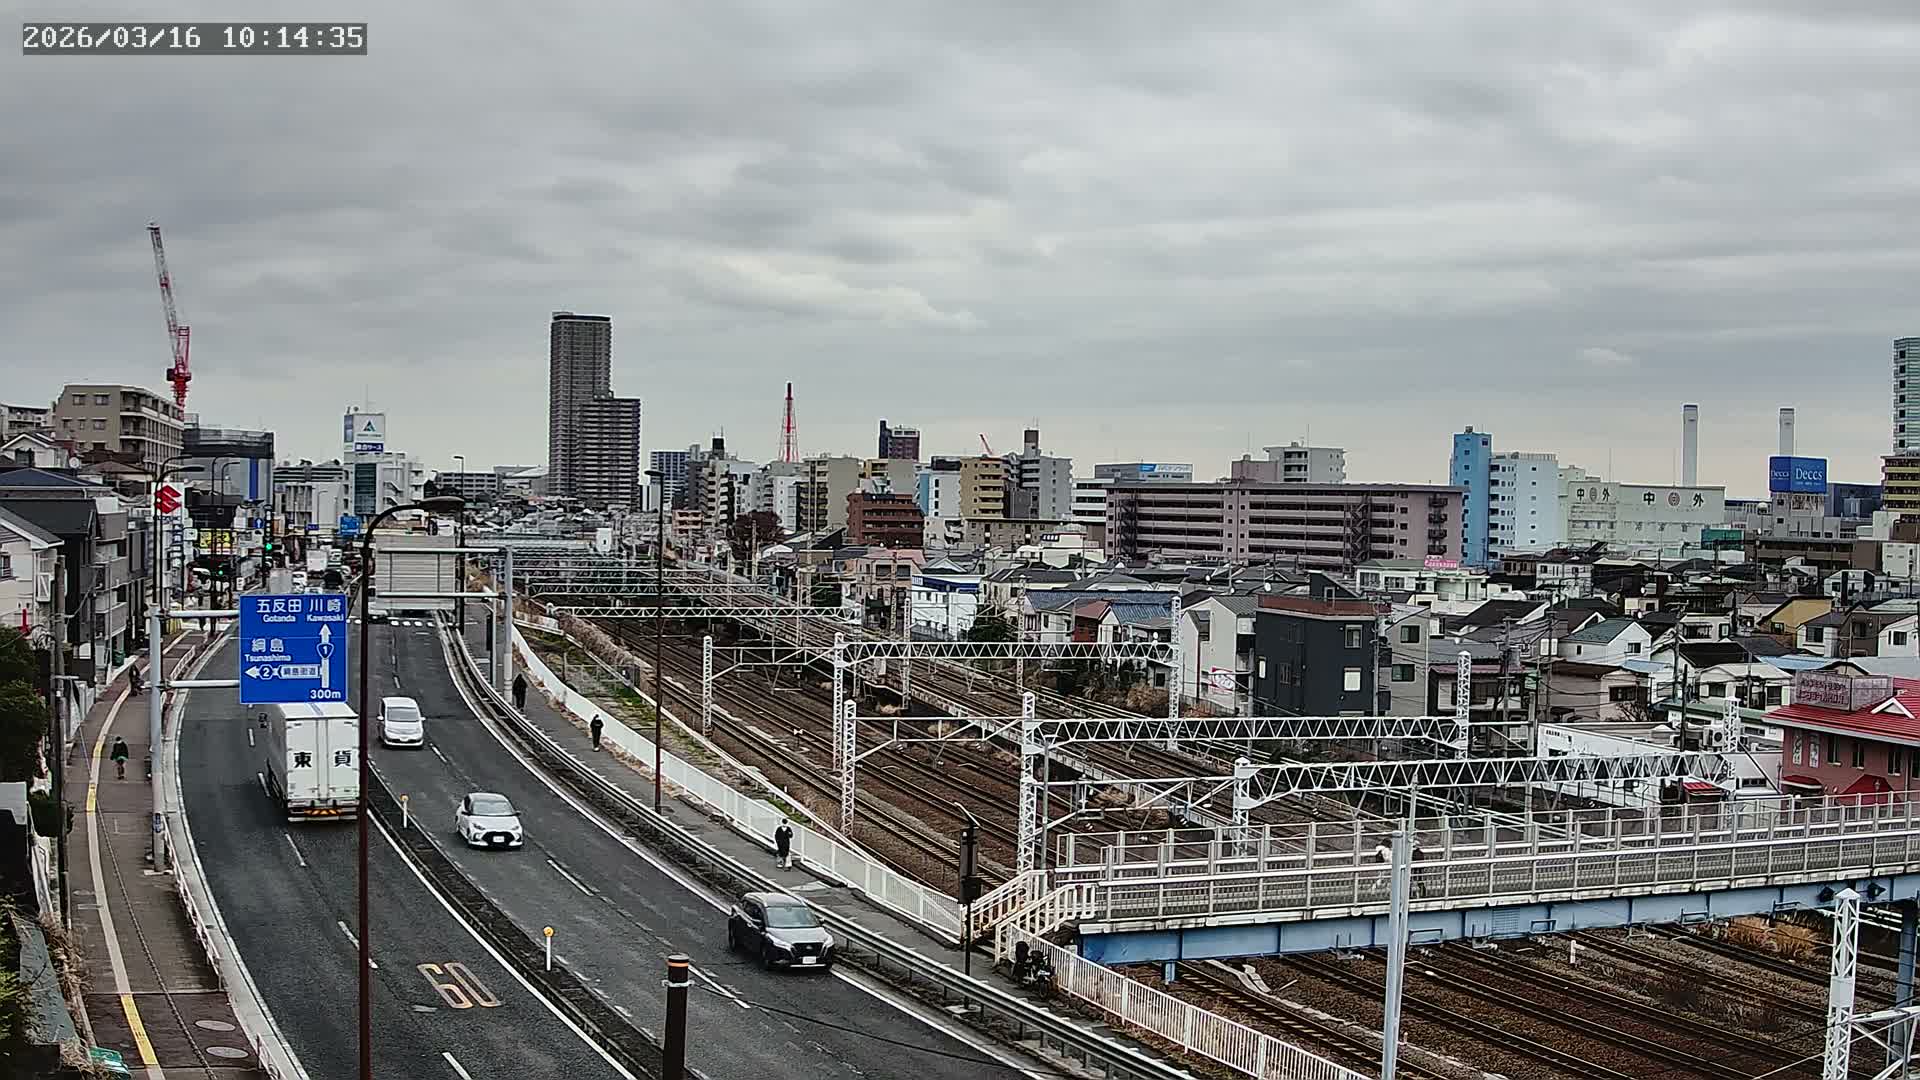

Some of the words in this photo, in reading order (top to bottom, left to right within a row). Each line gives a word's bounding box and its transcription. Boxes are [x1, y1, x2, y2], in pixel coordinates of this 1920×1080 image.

[1795, 467, 1823, 480] Deccs
[256, 599, 302, 613] 五反田
[309, 599, 341, 613] 川崎
[263, 614, 296, 623] Gotanda
[306, 614, 344, 622] Kawasaki
[251, 638, 284, 653] 綱島
[244, 653, 292, 662] Tsunashima
[262, 667, 270, 677] 2
[310, 689, 341, 699] 300m
[416, 962, 502, 1009] 60
